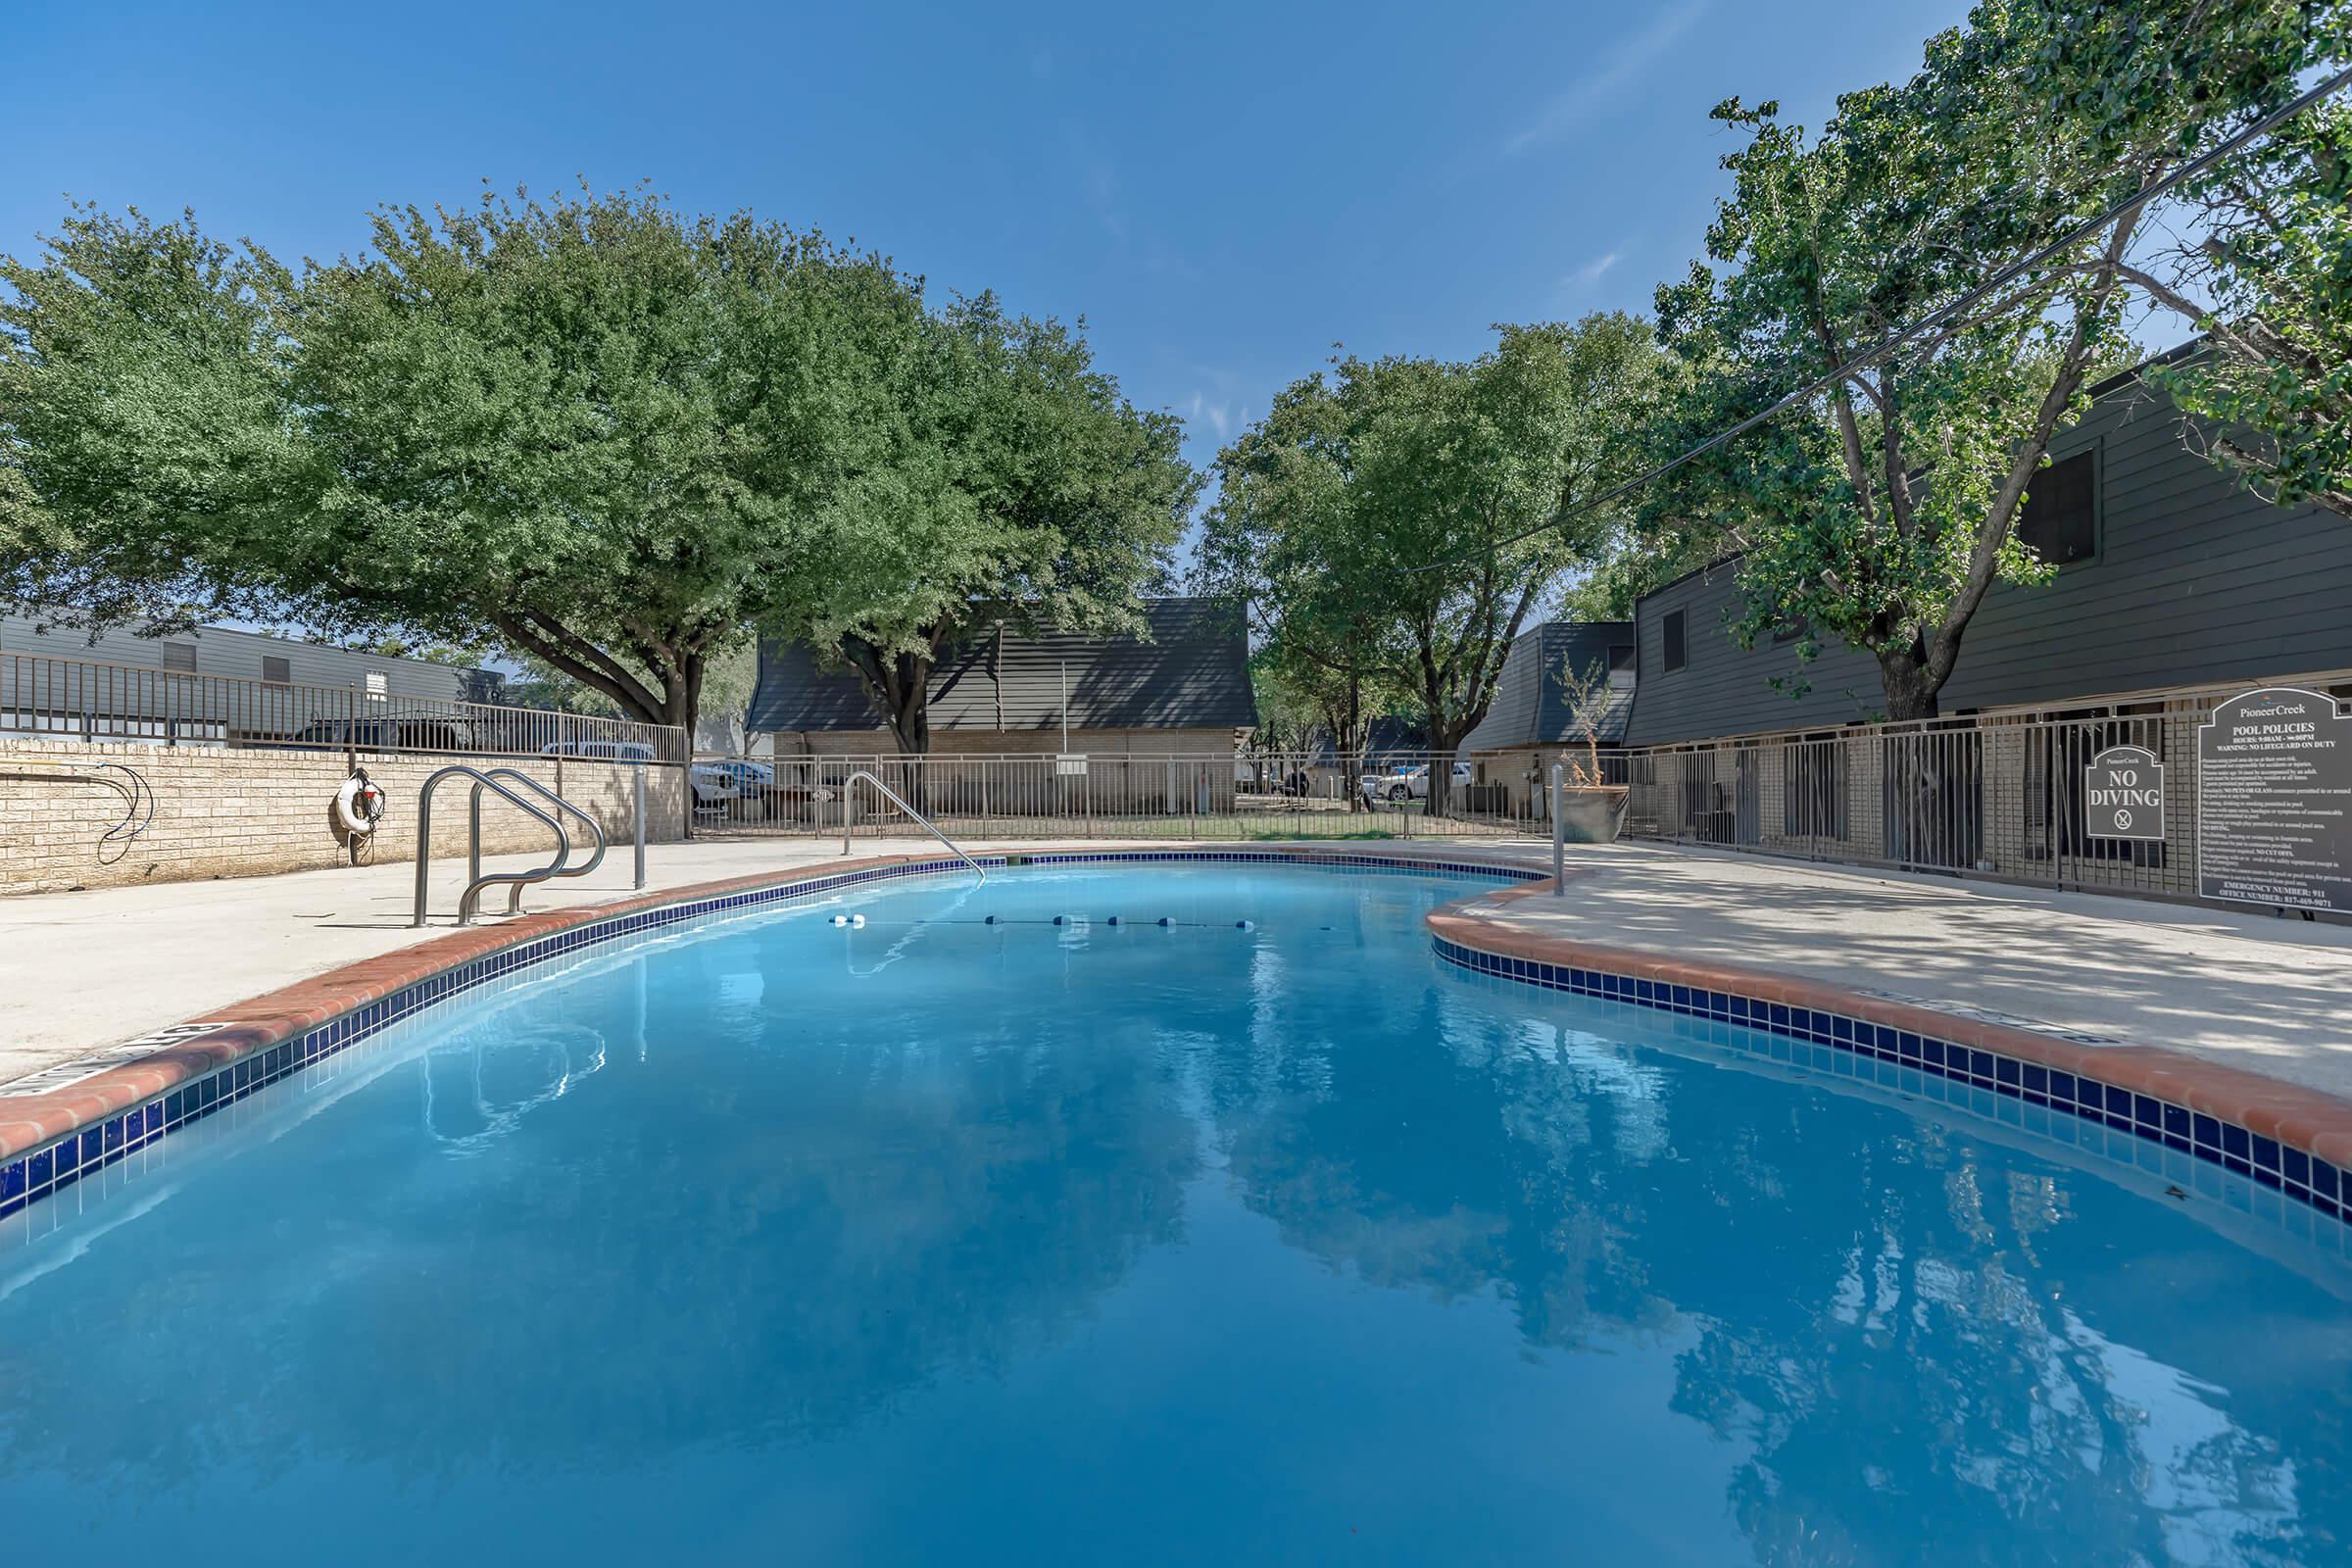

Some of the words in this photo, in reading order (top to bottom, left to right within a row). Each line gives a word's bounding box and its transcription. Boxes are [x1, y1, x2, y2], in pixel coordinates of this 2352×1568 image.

[2232, 726, 2261, 735] POOL
[2263, 722, 2315, 735] POLICIES
[2109, 770, 2136, 786] NO
[2089, 790, 2160, 806] DIVING
[2224, 882, 2271, 892] EMERGENCY
[2273, 886, 2311, 897] NUMBER:
[2246, 892, 2283, 902] NUMBER:
